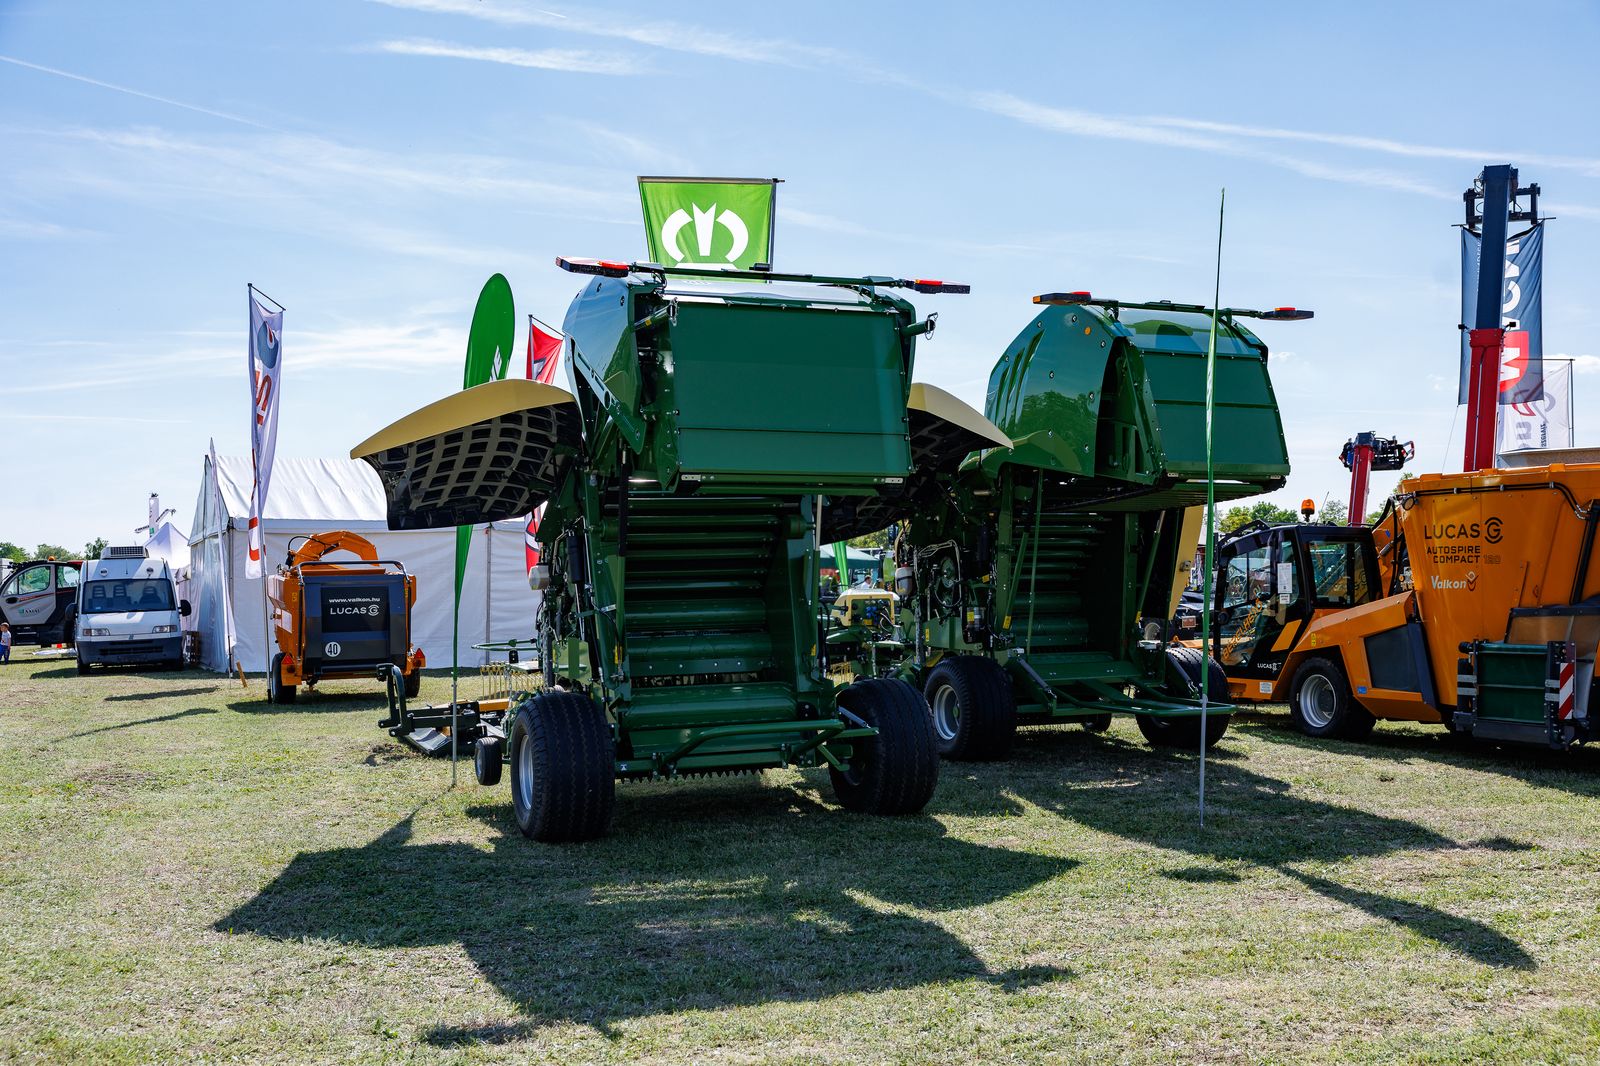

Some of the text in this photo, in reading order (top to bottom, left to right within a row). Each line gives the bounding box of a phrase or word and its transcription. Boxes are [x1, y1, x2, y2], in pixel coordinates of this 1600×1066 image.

[1424, 523, 1480, 540] LUCAS
[1426, 545, 1481, 555] AUTOSPIRE
[1433, 555, 1481, 564] COMPACT
[1430, 575, 1467, 590] Valkon
[330, 607, 367, 615] LUCAS
[327, 643, 338, 656] 40
